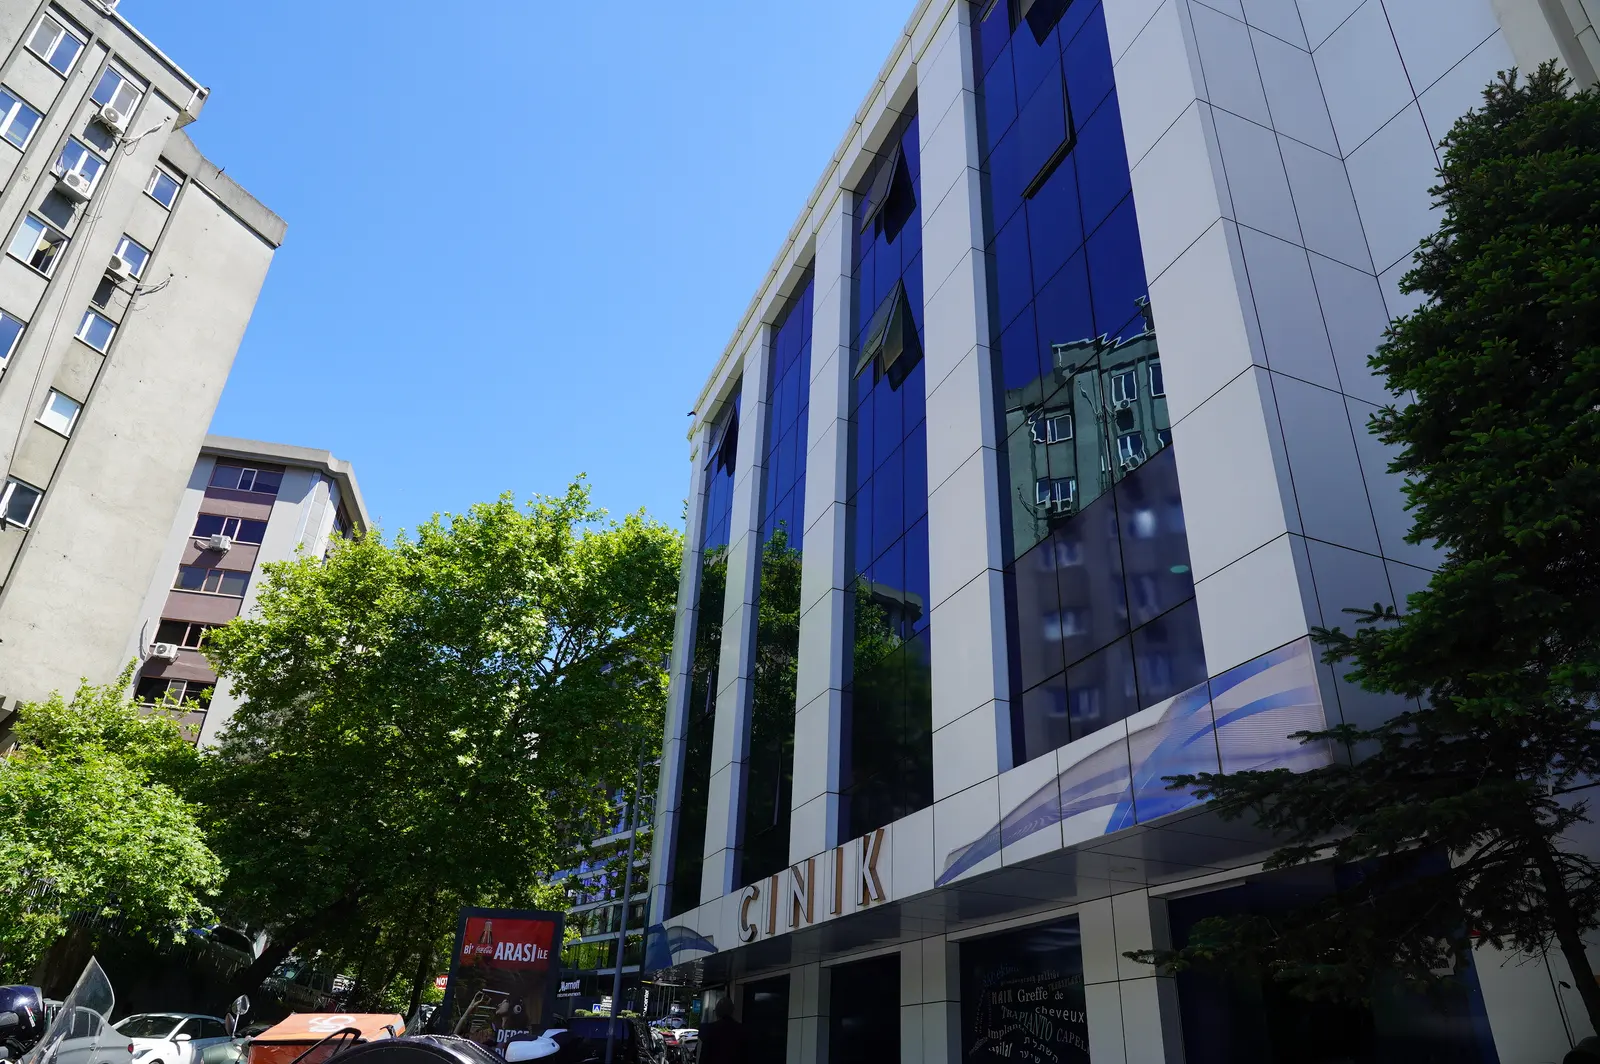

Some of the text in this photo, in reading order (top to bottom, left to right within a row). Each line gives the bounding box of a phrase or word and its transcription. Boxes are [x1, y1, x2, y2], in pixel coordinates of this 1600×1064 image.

[738, 828, 886, 943] CINIK
[493, 941, 537, 962] ARASI
[1017, 987, 1064, 1003] Greffe de
[1001, 1005, 1053, 1042] TRAPIANTO
[1035, 1006, 1085, 1023] cheveux
